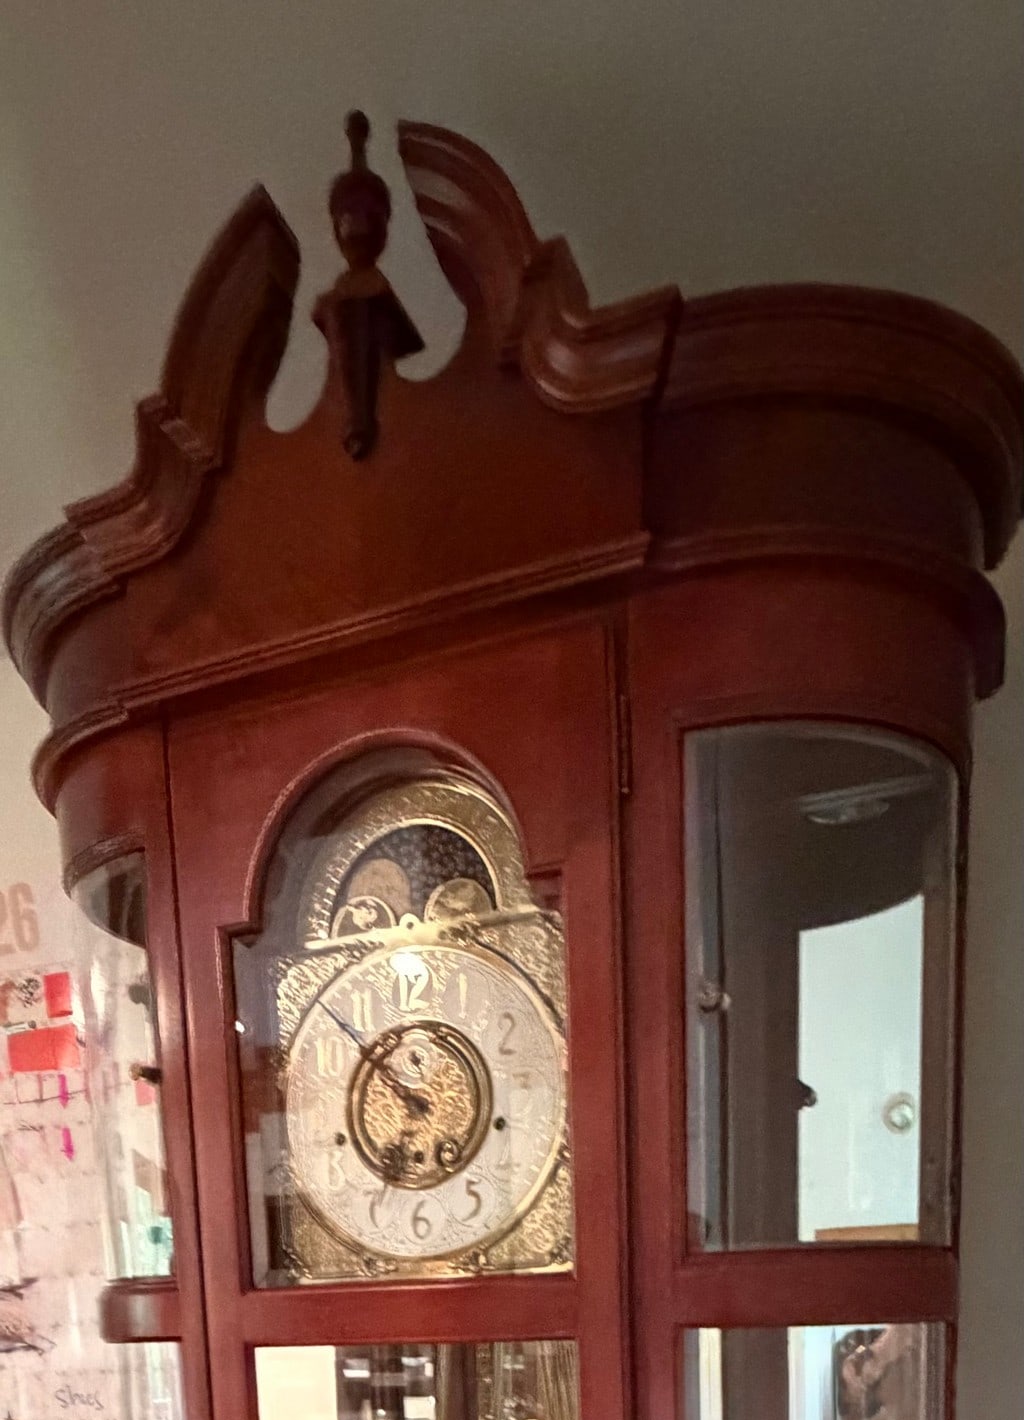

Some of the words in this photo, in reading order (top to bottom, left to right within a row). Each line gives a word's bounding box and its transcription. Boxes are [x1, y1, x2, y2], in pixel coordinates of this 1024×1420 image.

[351, 988, 375, 1032] 11
[499, 1012, 516, 1055] 2
[315, 1036, 345, 1078] 10
[411, 1200, 431, 1239] 6
[462, 1180, 482, 1222] 5
